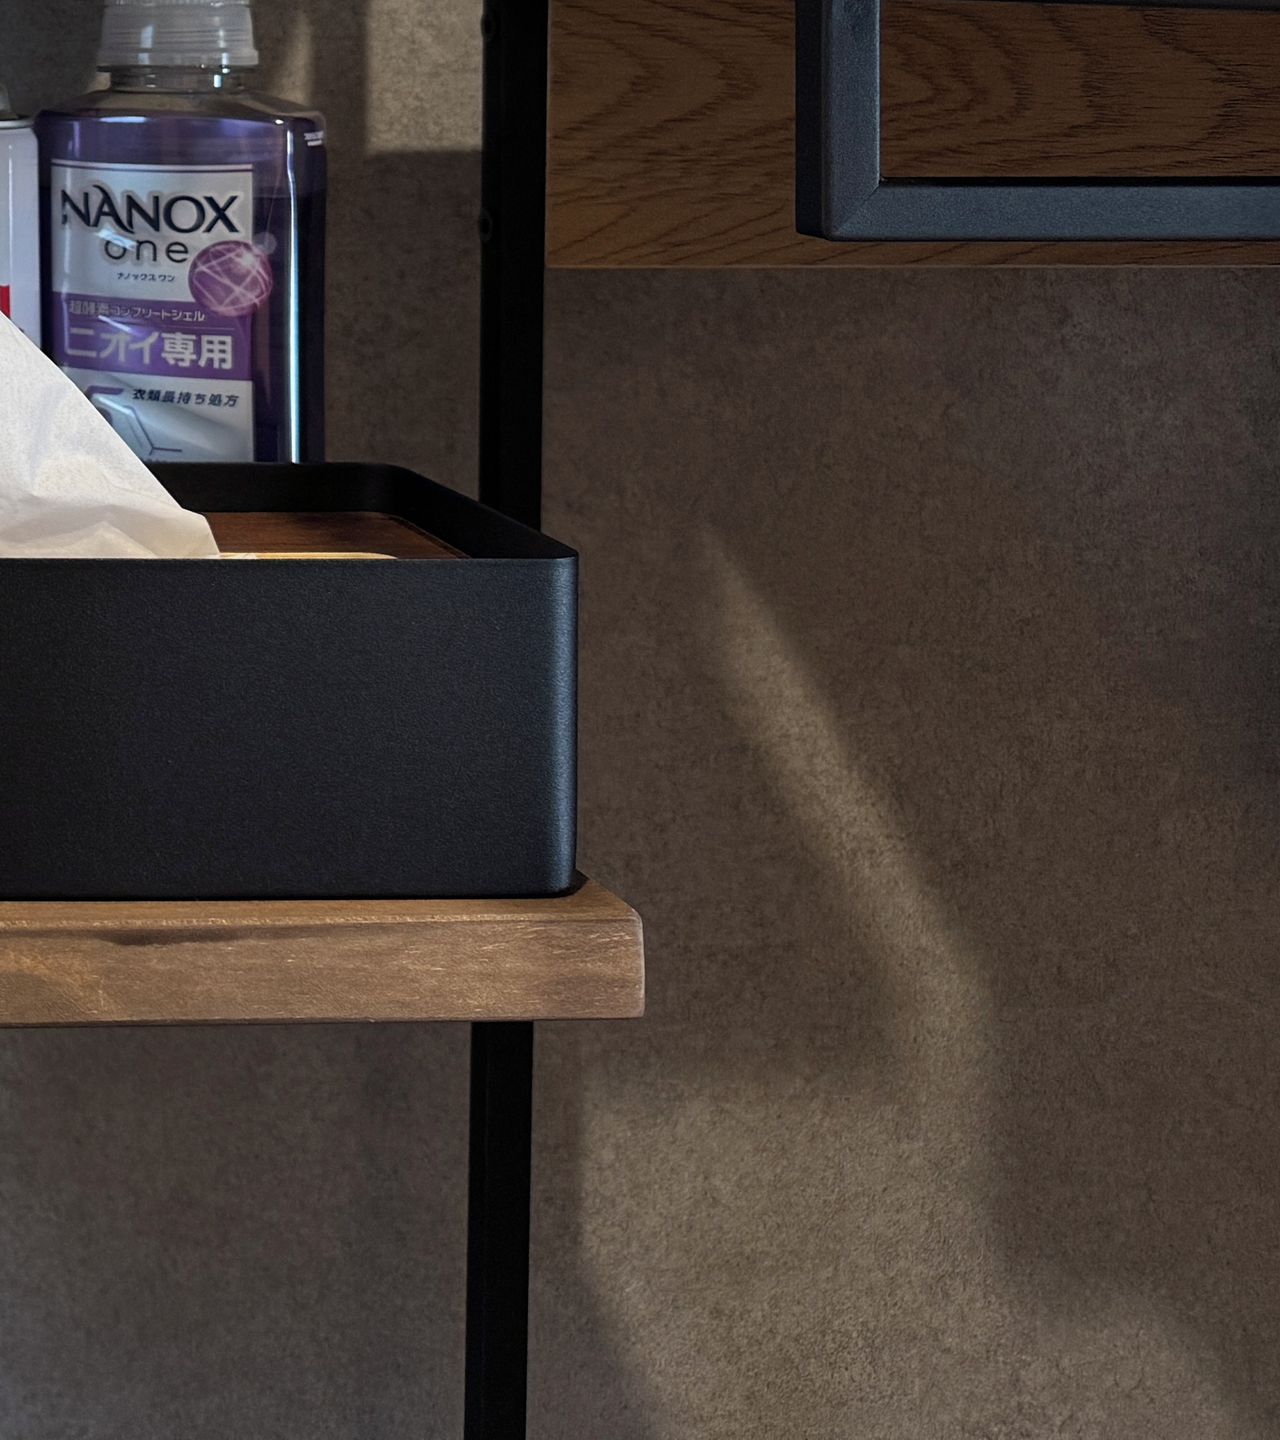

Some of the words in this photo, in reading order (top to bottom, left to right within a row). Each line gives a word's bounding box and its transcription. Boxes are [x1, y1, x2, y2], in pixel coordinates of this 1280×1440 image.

[61, 184, 239, 234] NANOX
[104, 239, 189, 263] one
[67, 327, 233, 370] ニオイ専用
[132, 388, 239, 408] 衣類長持ち処方
